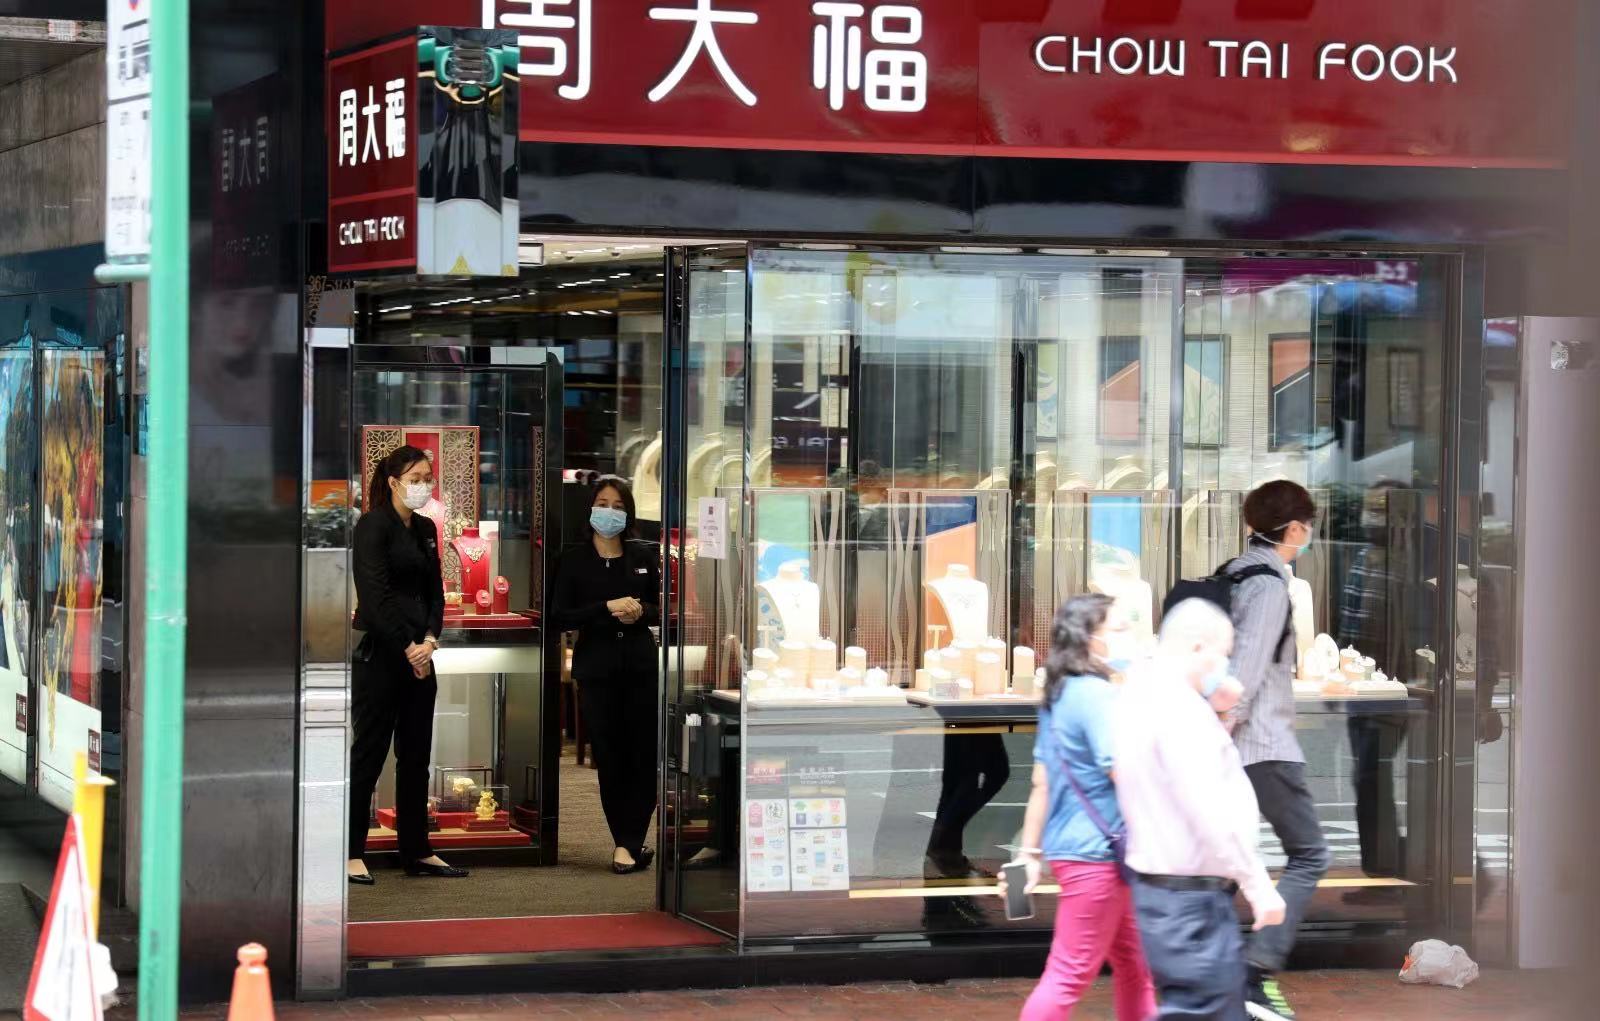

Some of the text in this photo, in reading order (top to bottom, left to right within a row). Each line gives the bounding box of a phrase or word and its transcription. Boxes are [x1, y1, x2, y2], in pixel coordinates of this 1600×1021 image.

[1034, 35, 1457, 83] CHOW TAI FOOK
[339, 78, 405, 166] 周大福
